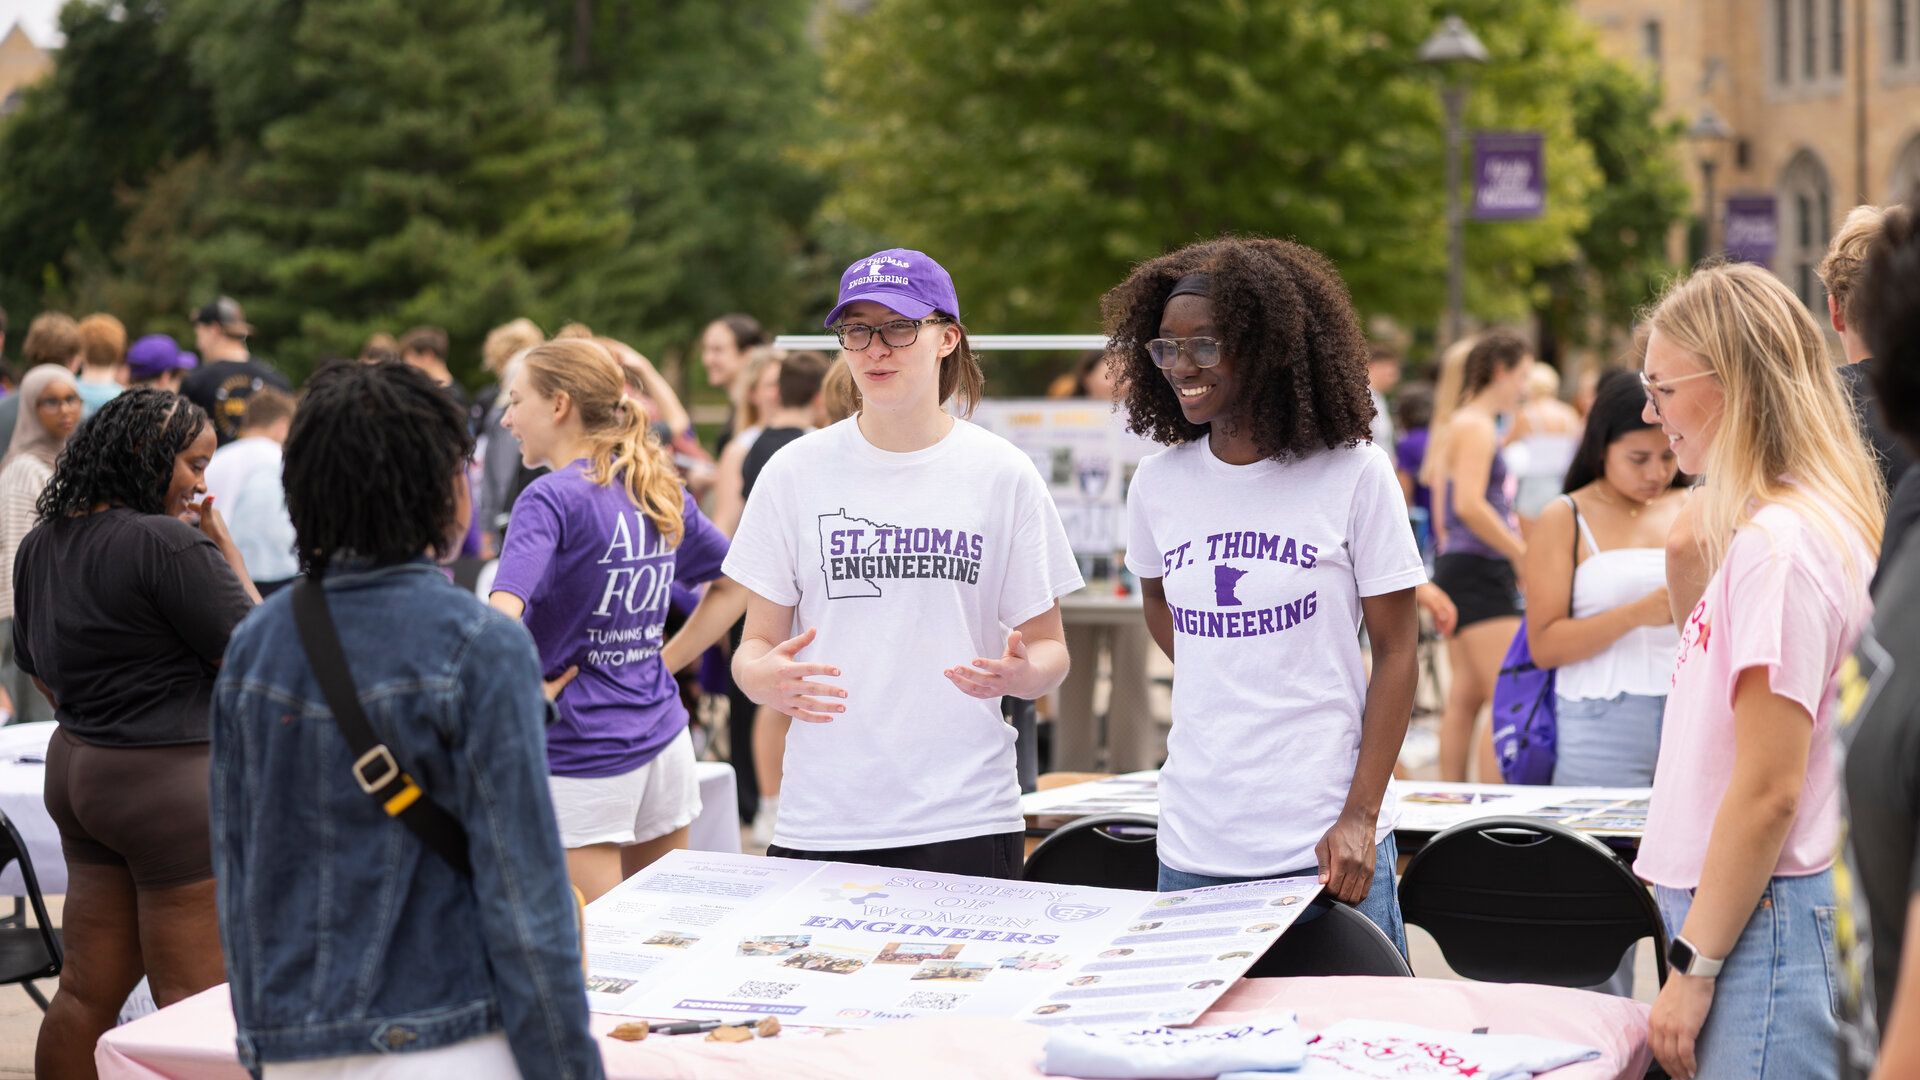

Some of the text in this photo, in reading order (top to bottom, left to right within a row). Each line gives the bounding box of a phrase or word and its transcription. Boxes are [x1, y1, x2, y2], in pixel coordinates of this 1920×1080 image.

[867, 256, 910, 269] THOMAS
[847, 275, 909, 290] ENGINEERING
[830, 527, 983, 561] ST. THOMAS
[1163, 531, 1319, 578] ST. THOMAS
[830, 555, 981, 585] ENGINEERING
[592, 561, 676, 616] FOR
[1167, 590, 1317, 638] NGINEERING
[884, 876, 1078, 901] SOCIETY
[862, 904, 1039, 929] WOMEN
[934, 896, 997, 911] OF
[800, 914, 1061, 945] ENGINEERS
[680, 1000, 802, 1014] TOMMIE LINK
